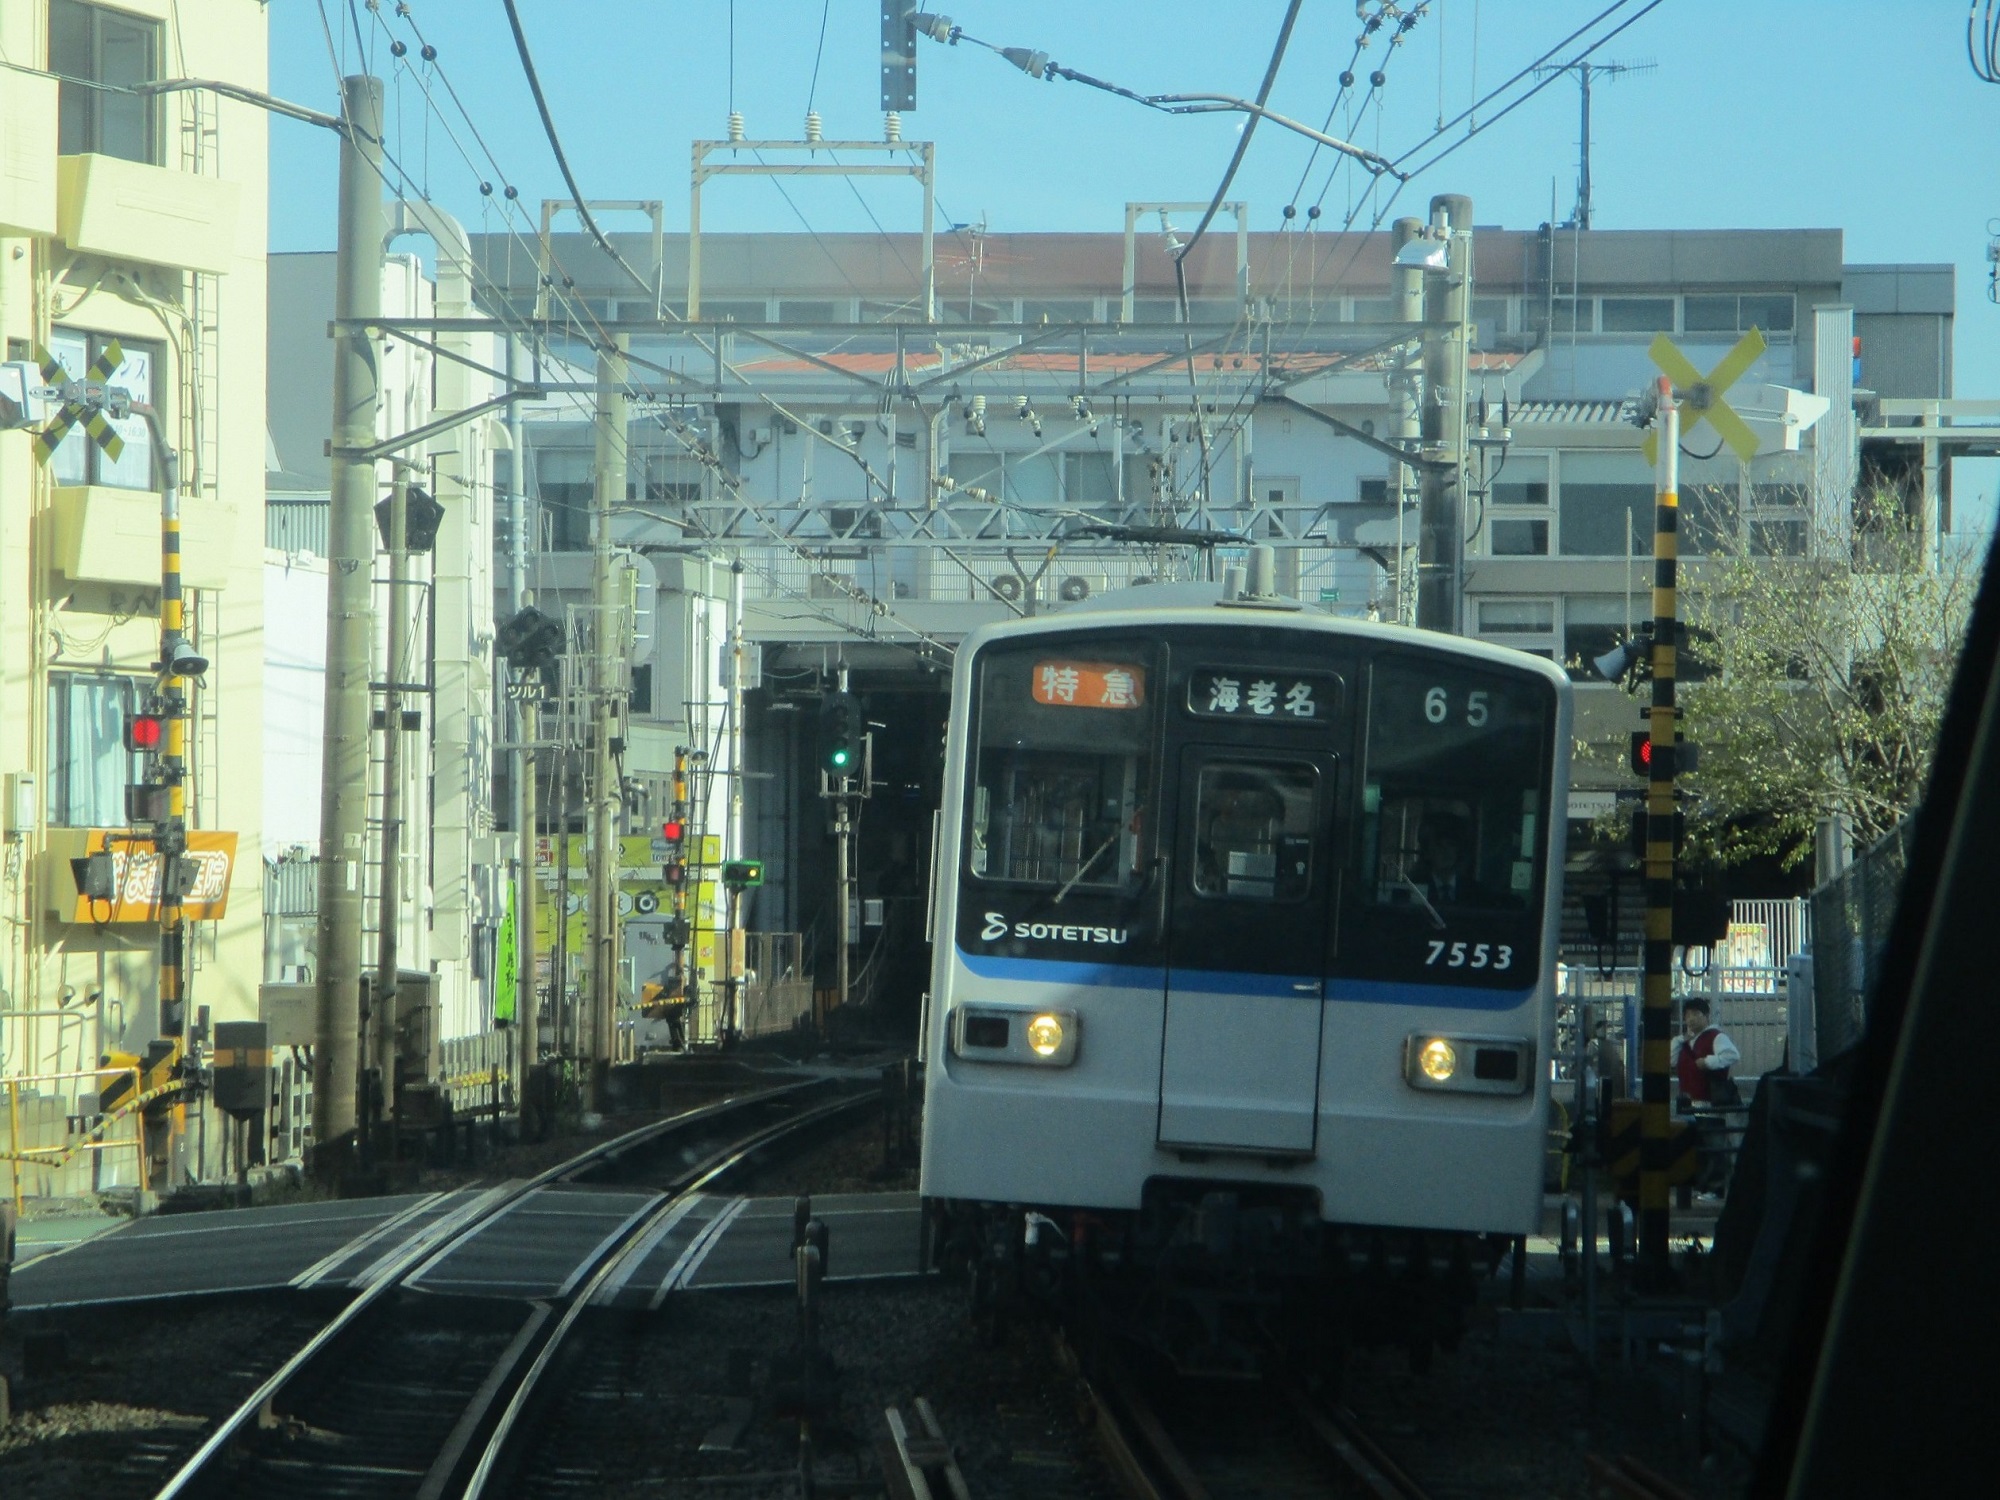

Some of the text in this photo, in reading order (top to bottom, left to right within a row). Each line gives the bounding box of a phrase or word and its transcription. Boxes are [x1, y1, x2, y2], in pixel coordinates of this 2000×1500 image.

[507, 685, 546, 699] ツル1
[1042, 665, 1138, 706] 特急
[1208, 677, 1316, 717] 海老名
[1014, 922, 1128, 944] SOTETSU
[1424, 941, 1513, 970] 7553
